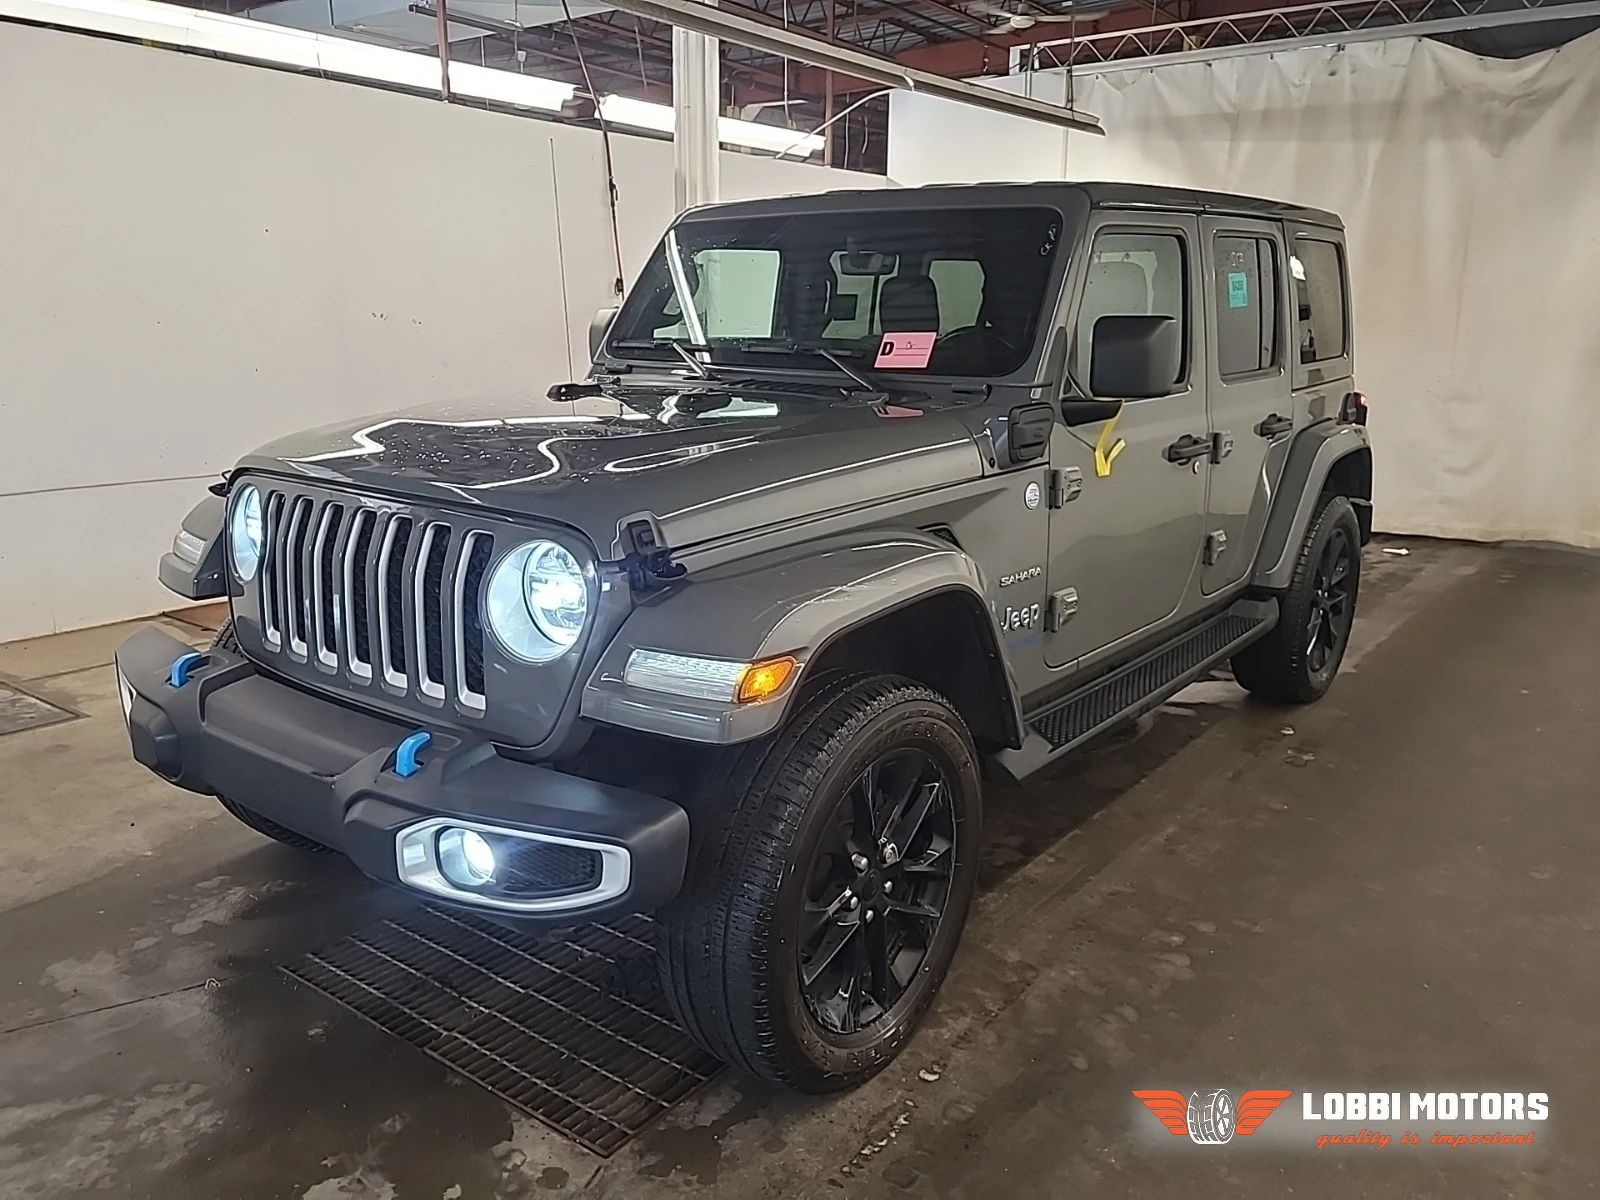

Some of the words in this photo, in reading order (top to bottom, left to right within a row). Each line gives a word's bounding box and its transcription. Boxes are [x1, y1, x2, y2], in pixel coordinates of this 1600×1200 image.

[880, 341, 895, 356] D
[1000, 566, 1041, 587] SAHARA
[1000, 603, 1040, 632] Jeep
